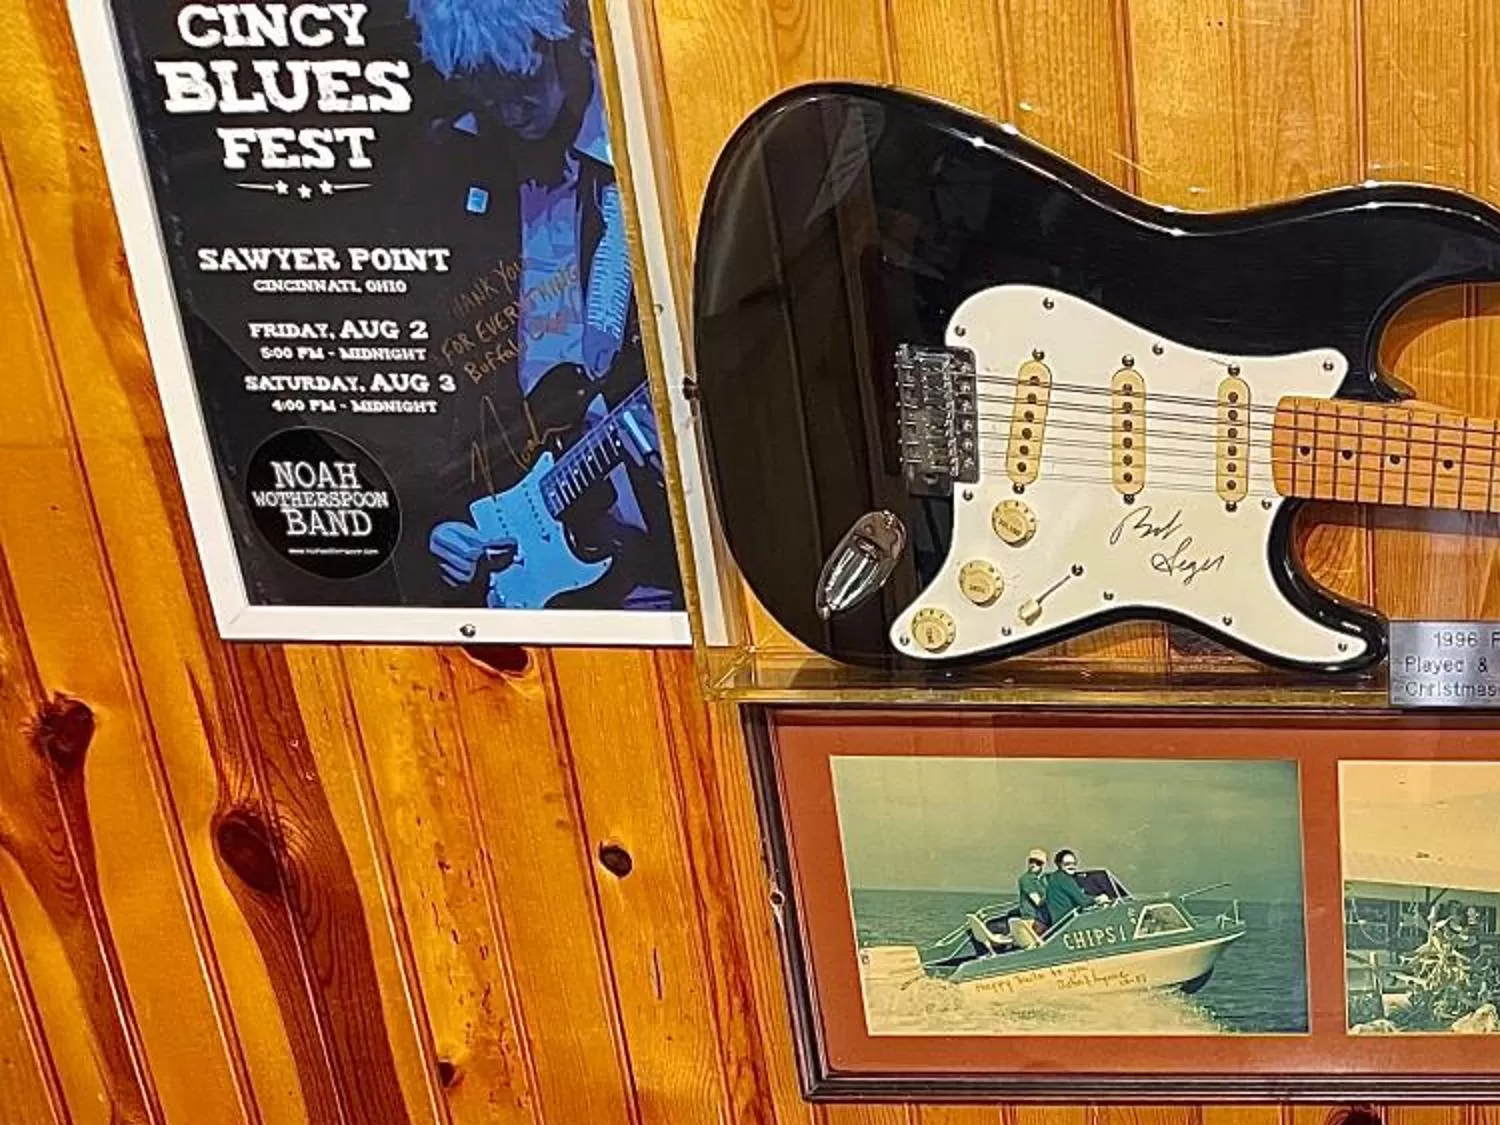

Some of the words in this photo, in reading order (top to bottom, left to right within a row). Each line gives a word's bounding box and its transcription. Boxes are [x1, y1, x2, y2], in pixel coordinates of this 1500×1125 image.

[178, 4, 368, 47] CINCY
[156, 60, 412, 114] BLUES
[218, 127, 376, 169] FEST
[198, 248, 341, 272] SAWYER
[348, 248, 451, 272] POINT
[365, 279, 407, 293] OHIO
[248, 322, 336, 340] FRIDAY,
[340, 320, 400, 339] AUG
[409, 320, 429, 339] 2
[260, 347, 293, 360] 5:00
[297, 347, 325, 360] PM
[339, 347, 427, 361] MIDNIGHT
[244, 375, 367, 393] SATURDAY,
[370, 373, 430, 392] AUG
[438, 373, 456, 392] 3
[271, 400, 305, 412] 4:00
[309, 400, 337, 412] PM
[351, 400, 439, 413] MIDNIGHT
[270, 461, 362, 489] NOAH
[251, 491, 389, 508] WOTHERSPOON
[280, 508, 373, 537] BAND
[1434, 632, 1478, 649] 1996
[1404, 658, 1465, 676] Played
[1477, 658, 1489, 673] &
[1405, 682, 1497, 697] Christmas
[1063, 926, 1117, 951] CHIPS
